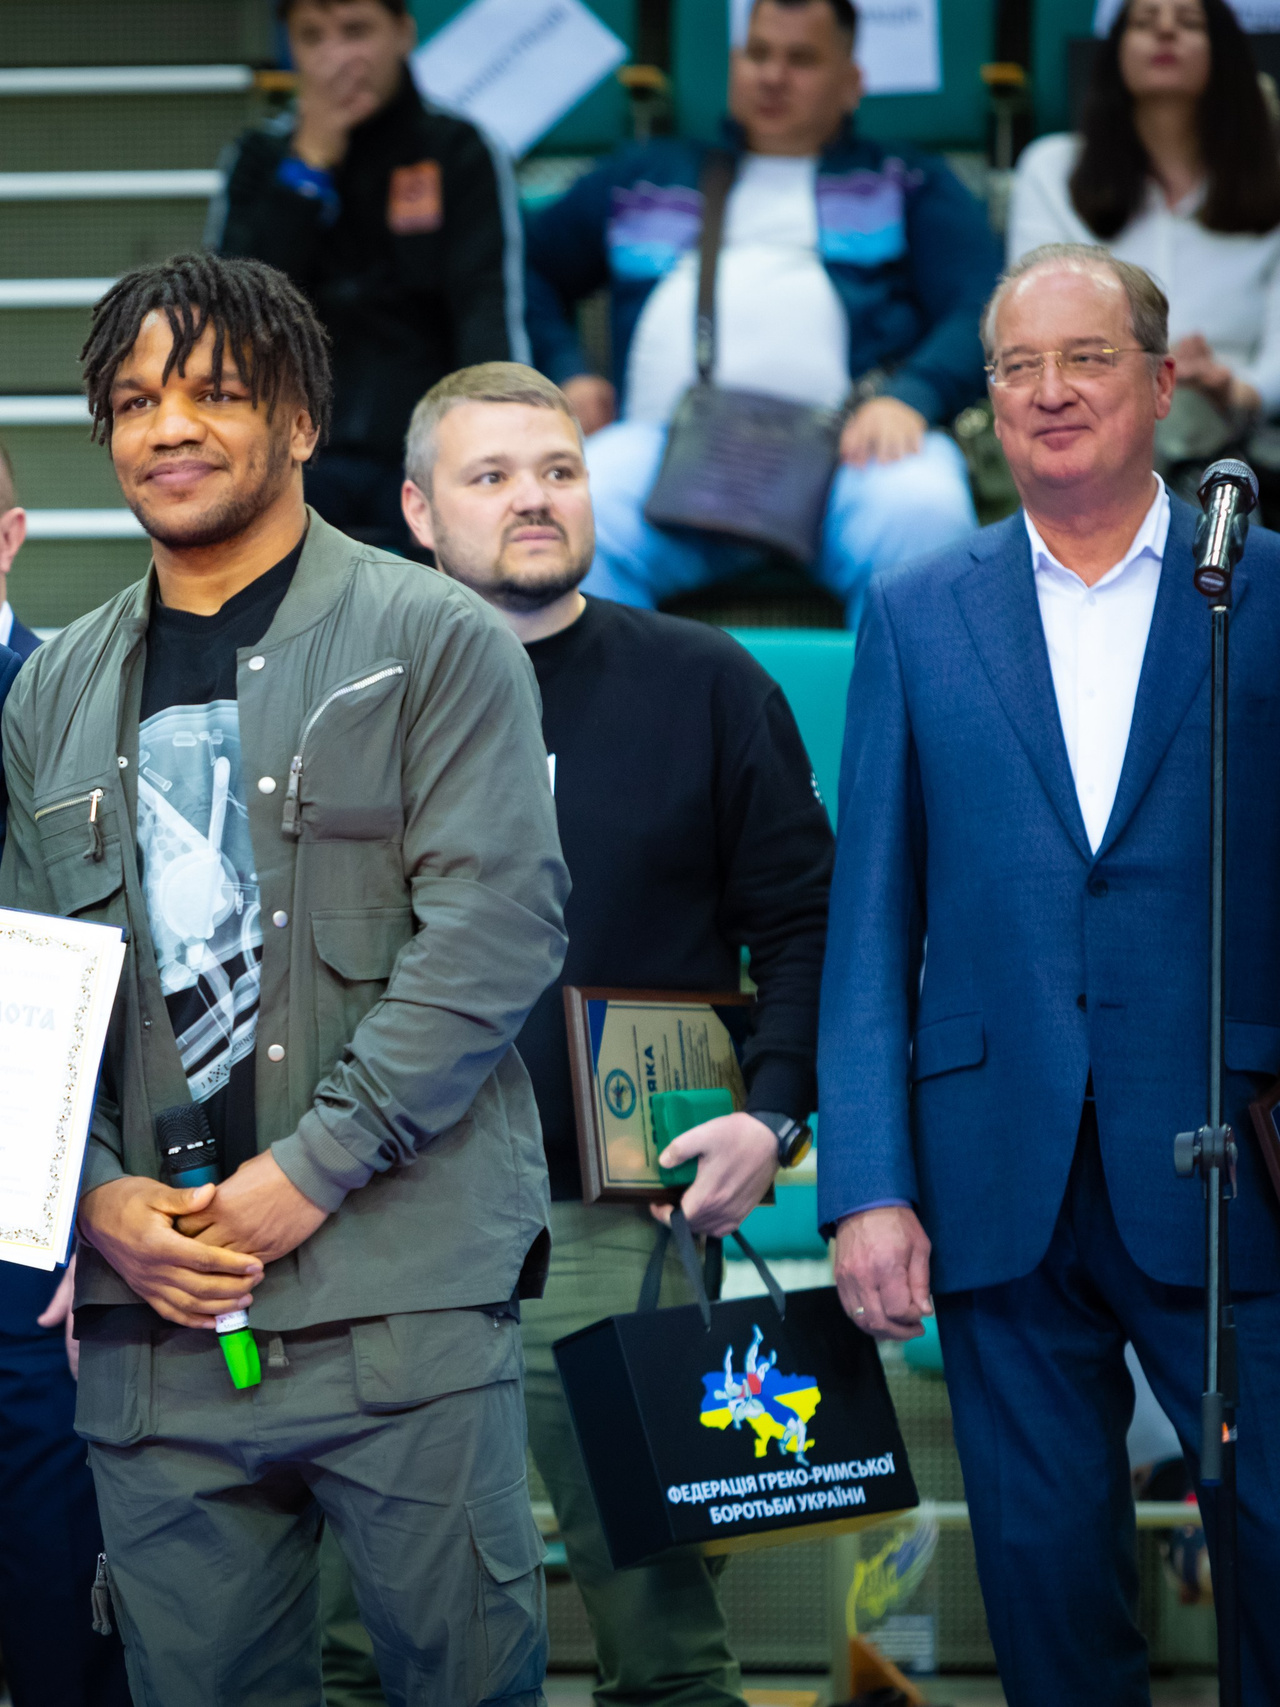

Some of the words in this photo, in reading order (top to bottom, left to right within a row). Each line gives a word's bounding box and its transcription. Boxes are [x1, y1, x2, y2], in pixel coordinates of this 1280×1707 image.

[667, 1475, 758, 1504] ФЕДЕРАЦІЯ
[759, 1452, 896, 1492] ГРЕКО-РИМСЬКОЇ
[709, 1496, 797, 1525] БОРОТЬБИ
[797, 1486, 867, 1512] УКРАЇНИ
